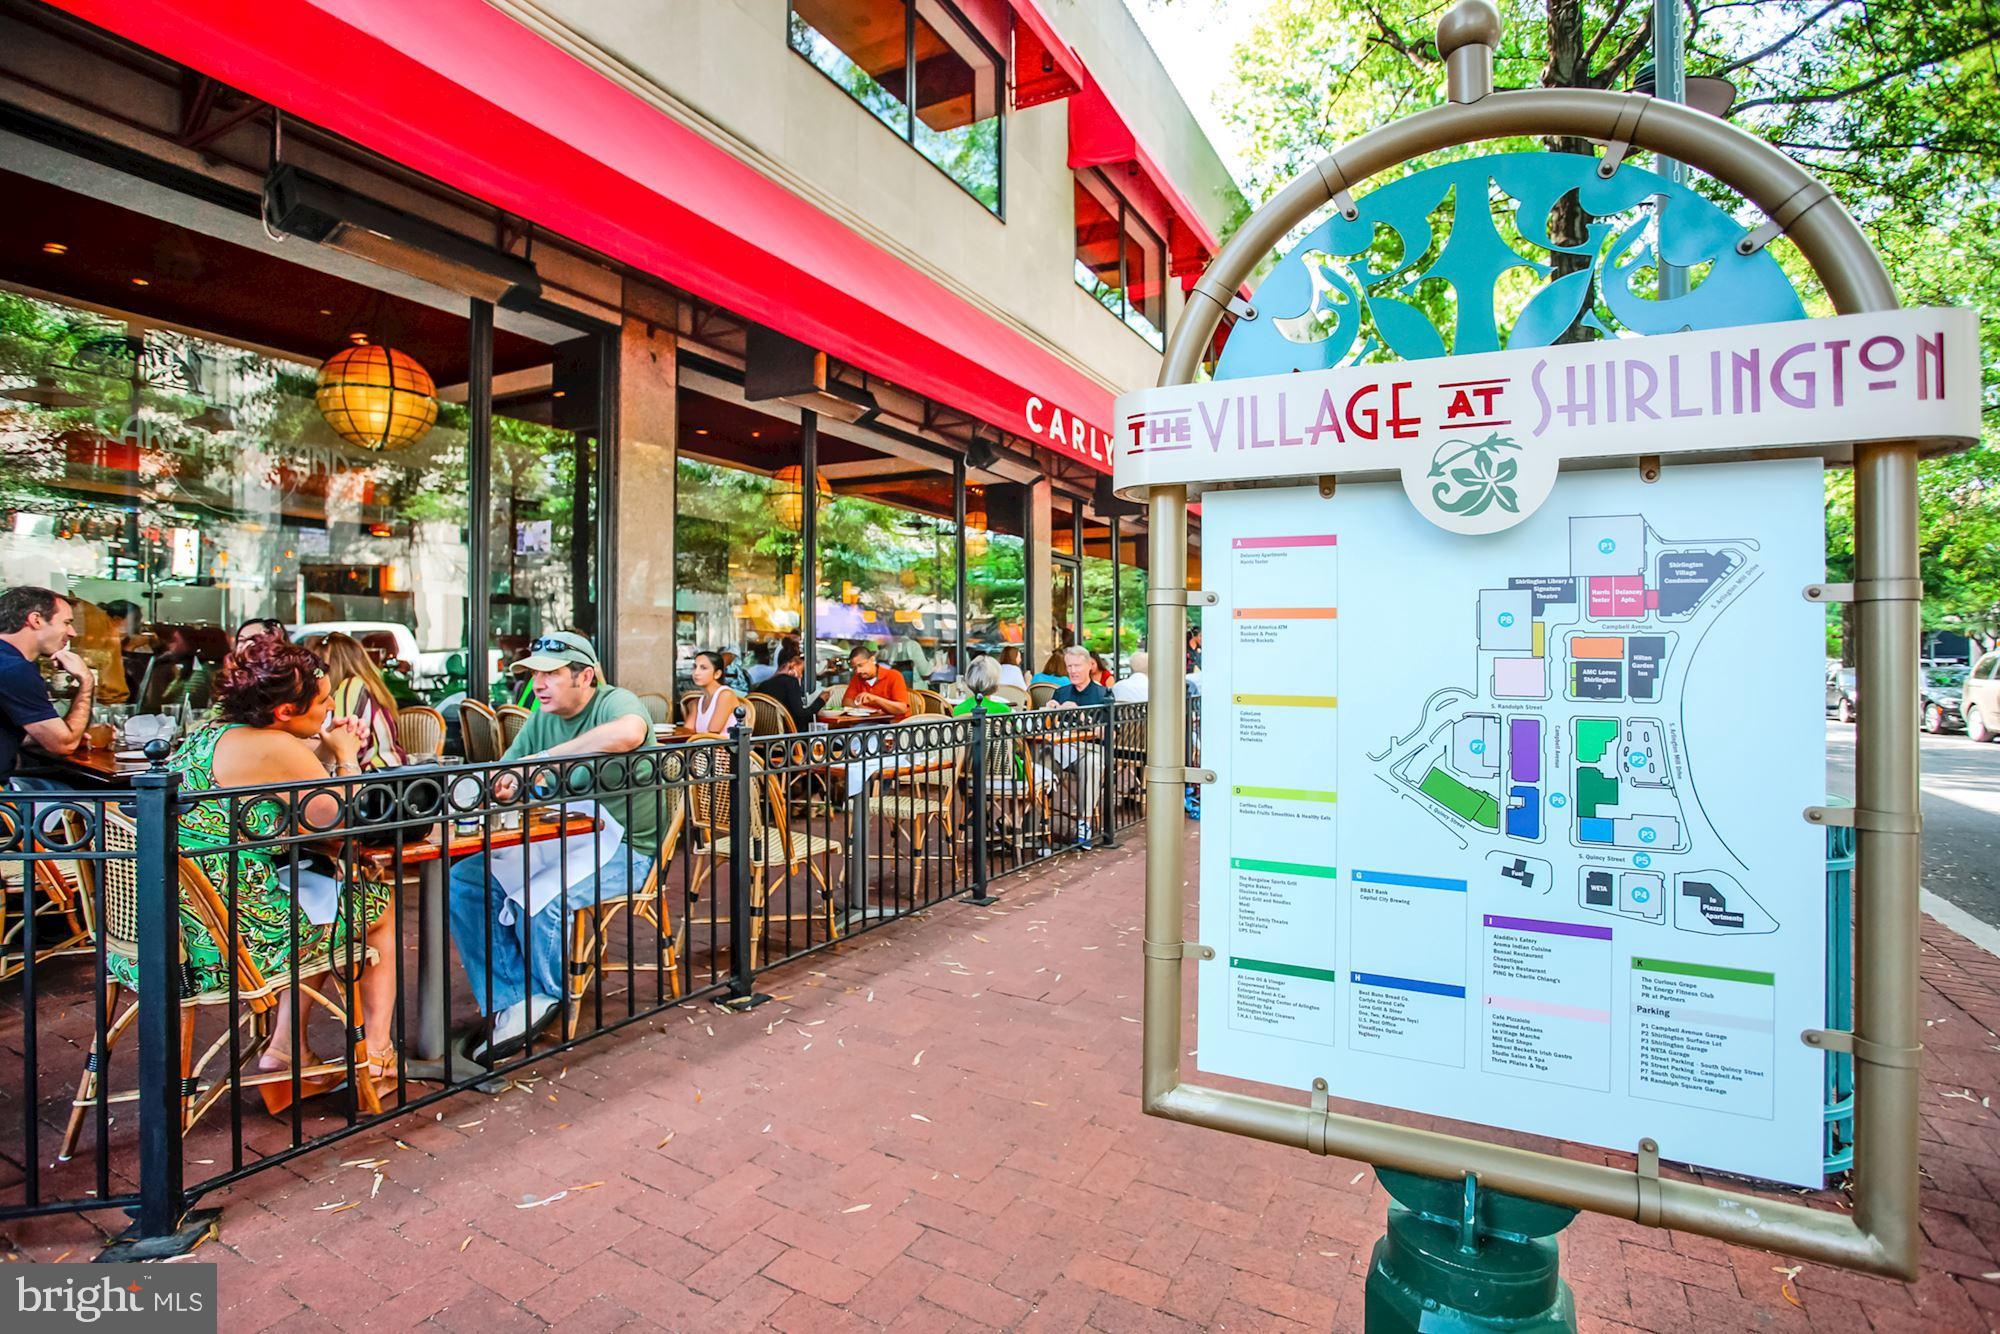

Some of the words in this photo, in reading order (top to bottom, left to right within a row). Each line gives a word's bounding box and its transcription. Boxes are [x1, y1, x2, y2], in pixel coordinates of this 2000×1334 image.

[1127, 413, 1192, 449] THE
[1197, 381, 1422, 453] VILLAGE
[1443, 383, 1507, 422] AT
[1531, 331, 1946, 438] SHIRLINGTON
[1585, 854, 1606, 862] Quincy
[1634, 891, 1647, 899] P4
[1702, 903, 1724, 912] Piazza
[1705, 913, 1743, 922] Apartments
[1514, 951, 1543, 959] Restaurant
[1516, 966, 1546, 974] Restaurant
[1654, 986, 1674, 994] Energy
[1636, 1005, 1670, 1018] Parking
[1651, 1024, 1679, 1033] Campbell
[1651, 1032, 1685, 1042] Shirlington
[1686, 1036, 1710, 1045] Surface
[1651, 1039, 1684, 1049] Shirlington
[1686, 1044, 1708, 1053] Garage
[1668, 1050, 1690, 1058] Garage
[1671, 1058, 1694, 1067] Parking
[1721, 1065, 1742, 1074] Quincy
[1744, 1069, 1764, 1077] Street
[1671, 1065, 1694, 1074] Parking
[1700, 1070, 1730, 1079] Campbell
[1670, 1073, 1691, 1081] Quincy
[1693, 1076, 1714, 1085] Garage
[1650, 1077, 1679, 1087] Randolph
[1681, 1082, 1702, 1090] Square
[1705, 1086, 1727, 1094] Garage
